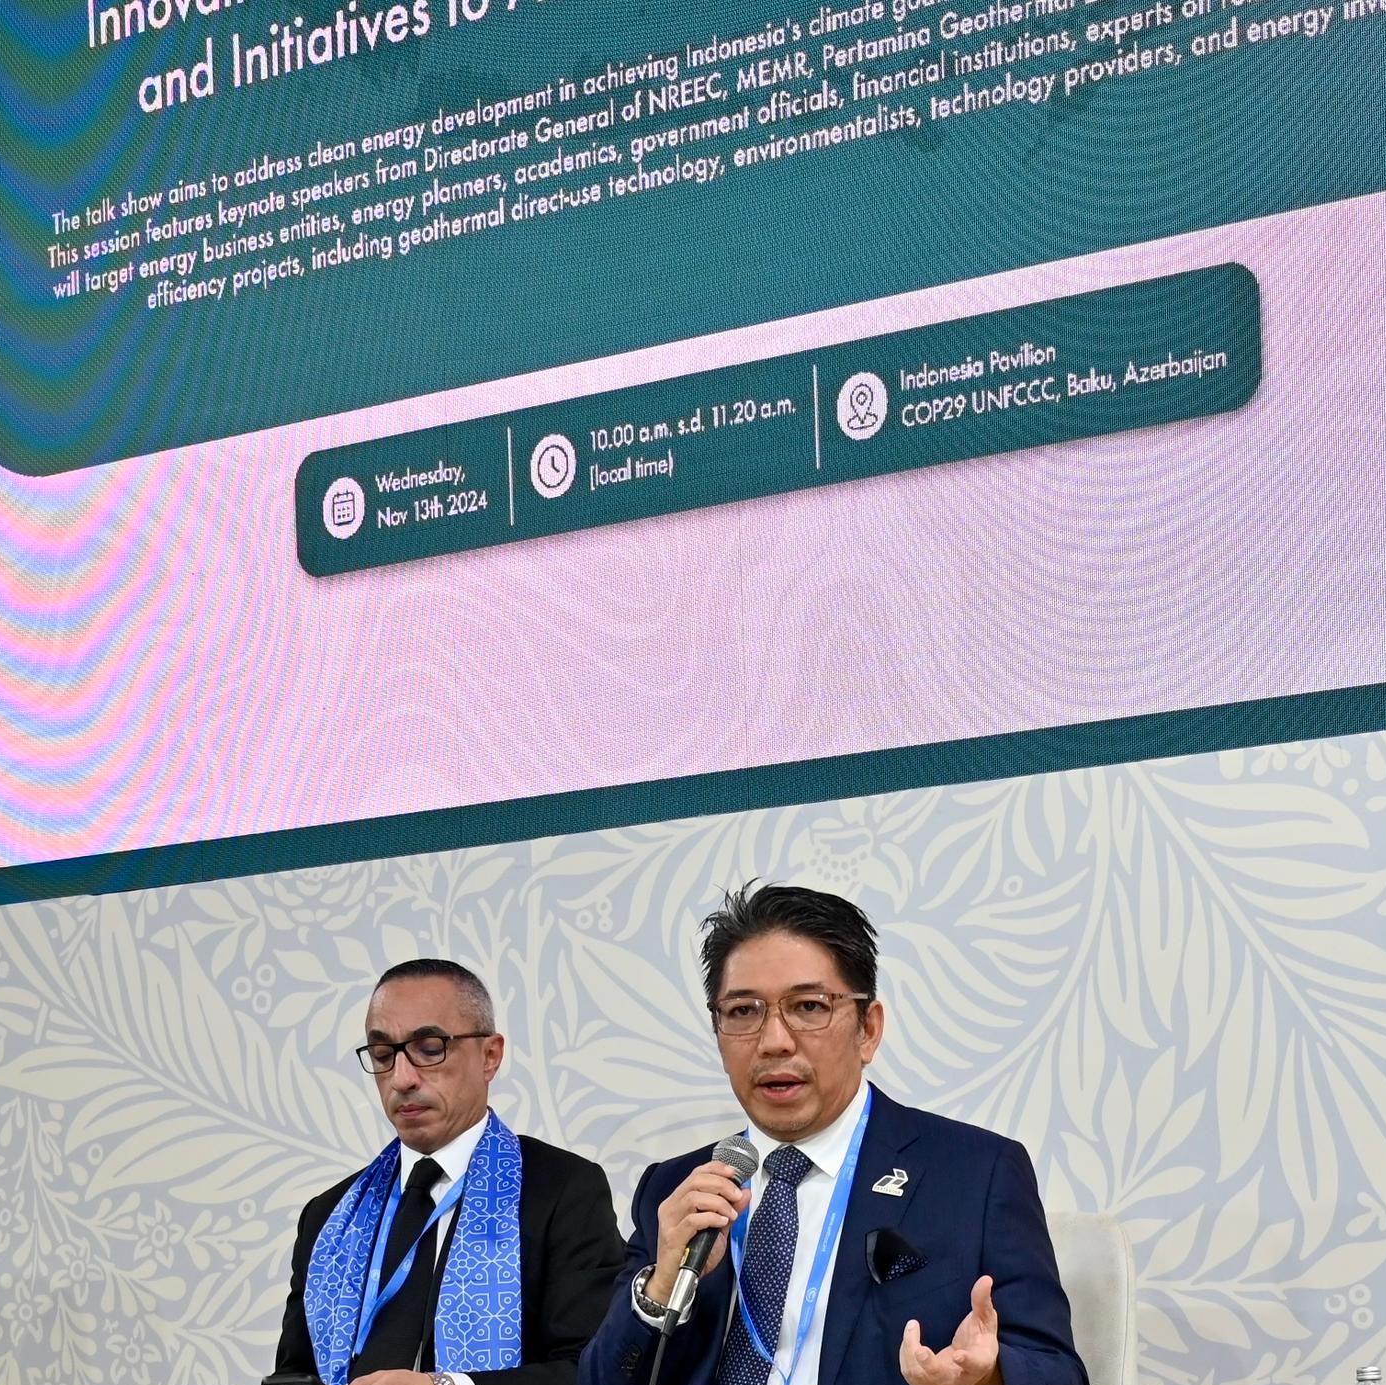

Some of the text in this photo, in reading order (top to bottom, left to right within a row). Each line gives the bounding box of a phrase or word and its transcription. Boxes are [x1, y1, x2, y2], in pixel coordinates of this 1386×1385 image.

[137, 37, 215, 114] and
[231, 0, 431, 87] Initiatives
[83, 51, 814, 260] session features keynote speakers from Directorate General NREEC, MEMR,
[85, 18, 802, 226] talk aims development Indonesia's
[202, 1, 1173, 263] business government financial experts
[147, 184, 601, 310] efficiency including direct-use
[900, 342, 1056, 391] Indonesia Pavilion
[901, 349, 1227, 428] COP29 UNFCCC, Baku, Azerbaijan
[590, 398, 796, 451] 10.00 a.m. s.d. 11.20 a.m.
[374, 459, 466, 493] Wednesday,
[377, 489, 488, 529] Nov 13th 2024
